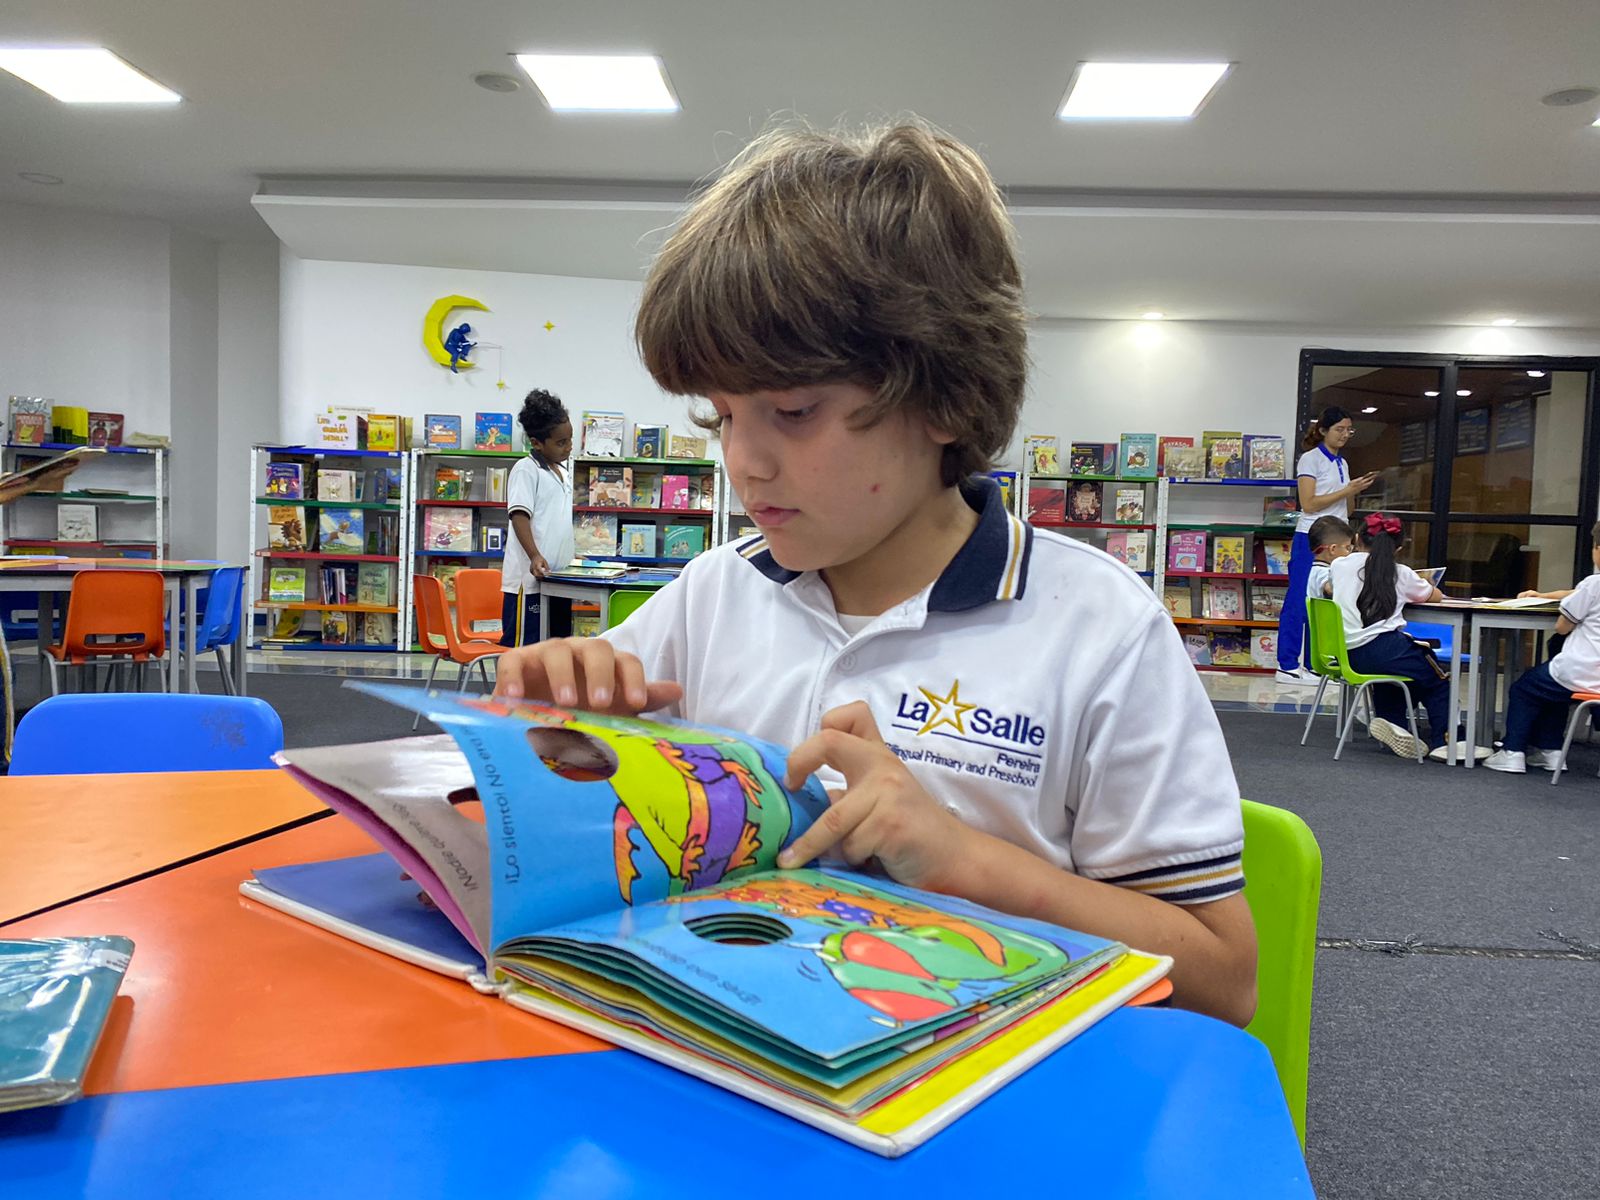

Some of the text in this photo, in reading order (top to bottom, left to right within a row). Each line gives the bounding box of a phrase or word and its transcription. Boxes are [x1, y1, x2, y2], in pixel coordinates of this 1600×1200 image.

[896, 693, 1045, 746] La Salle
[484, 763, 504, 788] No
[924, 751, 964, 773] Primary
[965, 762, 987, 776] and
[988, 767, 1038, 788] Preschool
[997, 753, 1041, 773] Pereira
